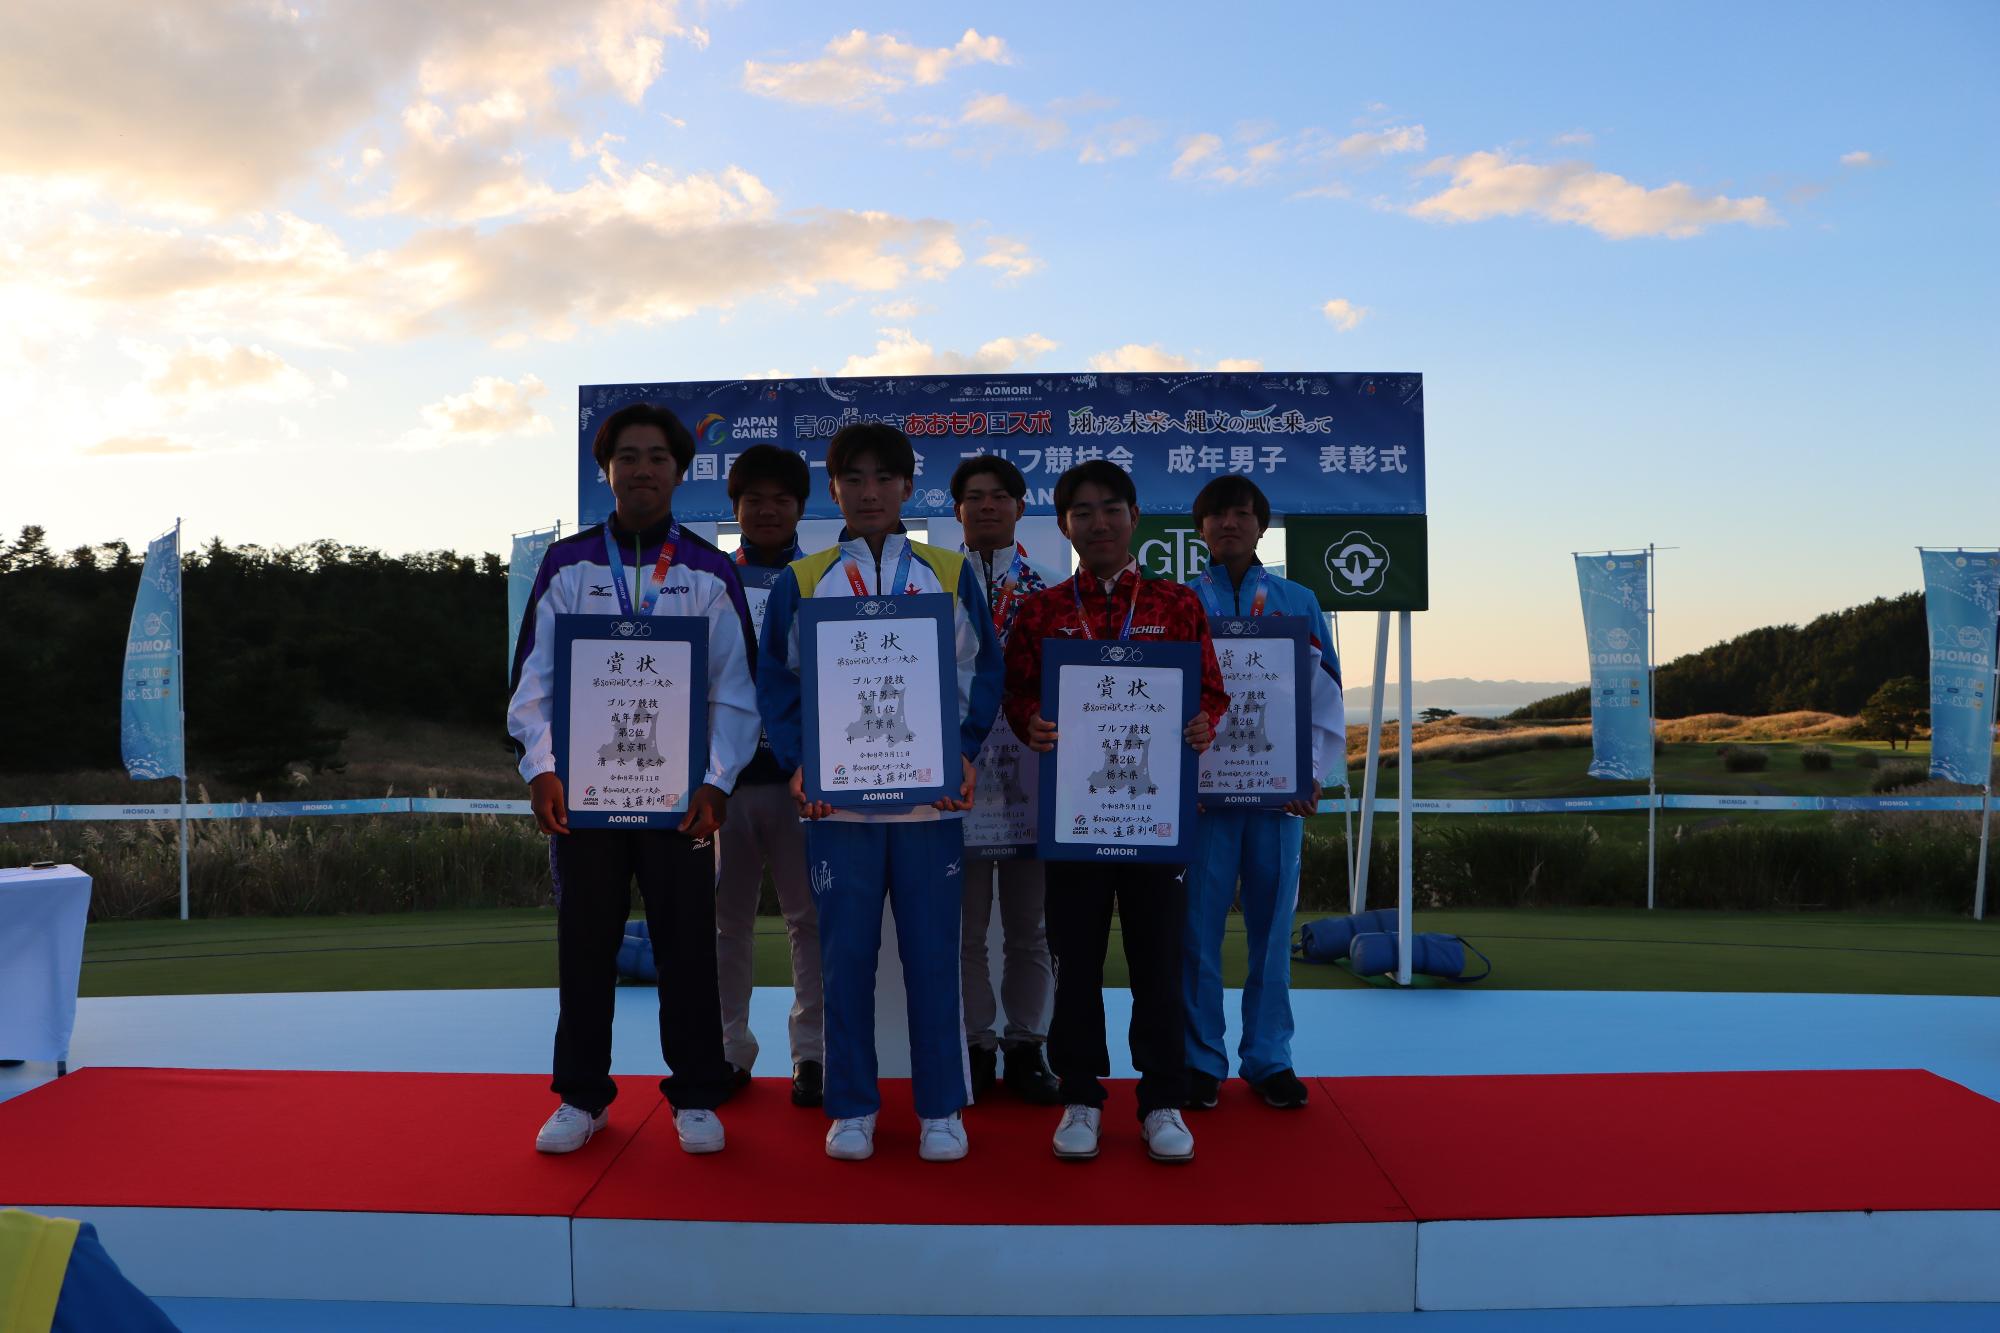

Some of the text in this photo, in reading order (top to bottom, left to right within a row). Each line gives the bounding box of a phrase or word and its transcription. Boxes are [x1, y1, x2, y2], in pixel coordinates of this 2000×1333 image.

[984, 386, 1032, 395] AOMORI
[732, 416, 778, 427] JAPAN
[732, 428, 778, 439] GAMES
[1167, 445, 1287, 473] 成年男子
[1319, 445, 1408, 473] 表彰式
[1129, 625, 1166, 635] OCHIGI
[851, 631, 903, 653] 賞状
[607, 651, 659, 674] 賞状
[852, 675, 905, 685] ゴルフ競技
[1097, 675, 1151, 699] 賞状
[857, 689, 901, 700] 成年男子
[1230, 690, 1267, 700] ルフ競技
[607, 699, 658, 709] ゴルフ競技
[863, 705, 895, 714] 第1位
[1229, 704, 1265, 713] 年男子
[611, 712, 653, 723] 成年男子
[863, 718, 895, 730] 千葉県
[1098, 723, 1151, 734] ゴルフ競技
[618, 728, 645, 738] 第2位
[616, 743, 647, 753] 東京都
[1102, 738, 1145, 749] 成年男子
[1109, 754, 1137, 765] 第2位
[1106, 769, 1139, 780] 栃木県
[862, 792, 904, 801] AOMORI
[608, 815, 648, 823] AOMORI
[1096, 847, 1138, 856] AOMORI
